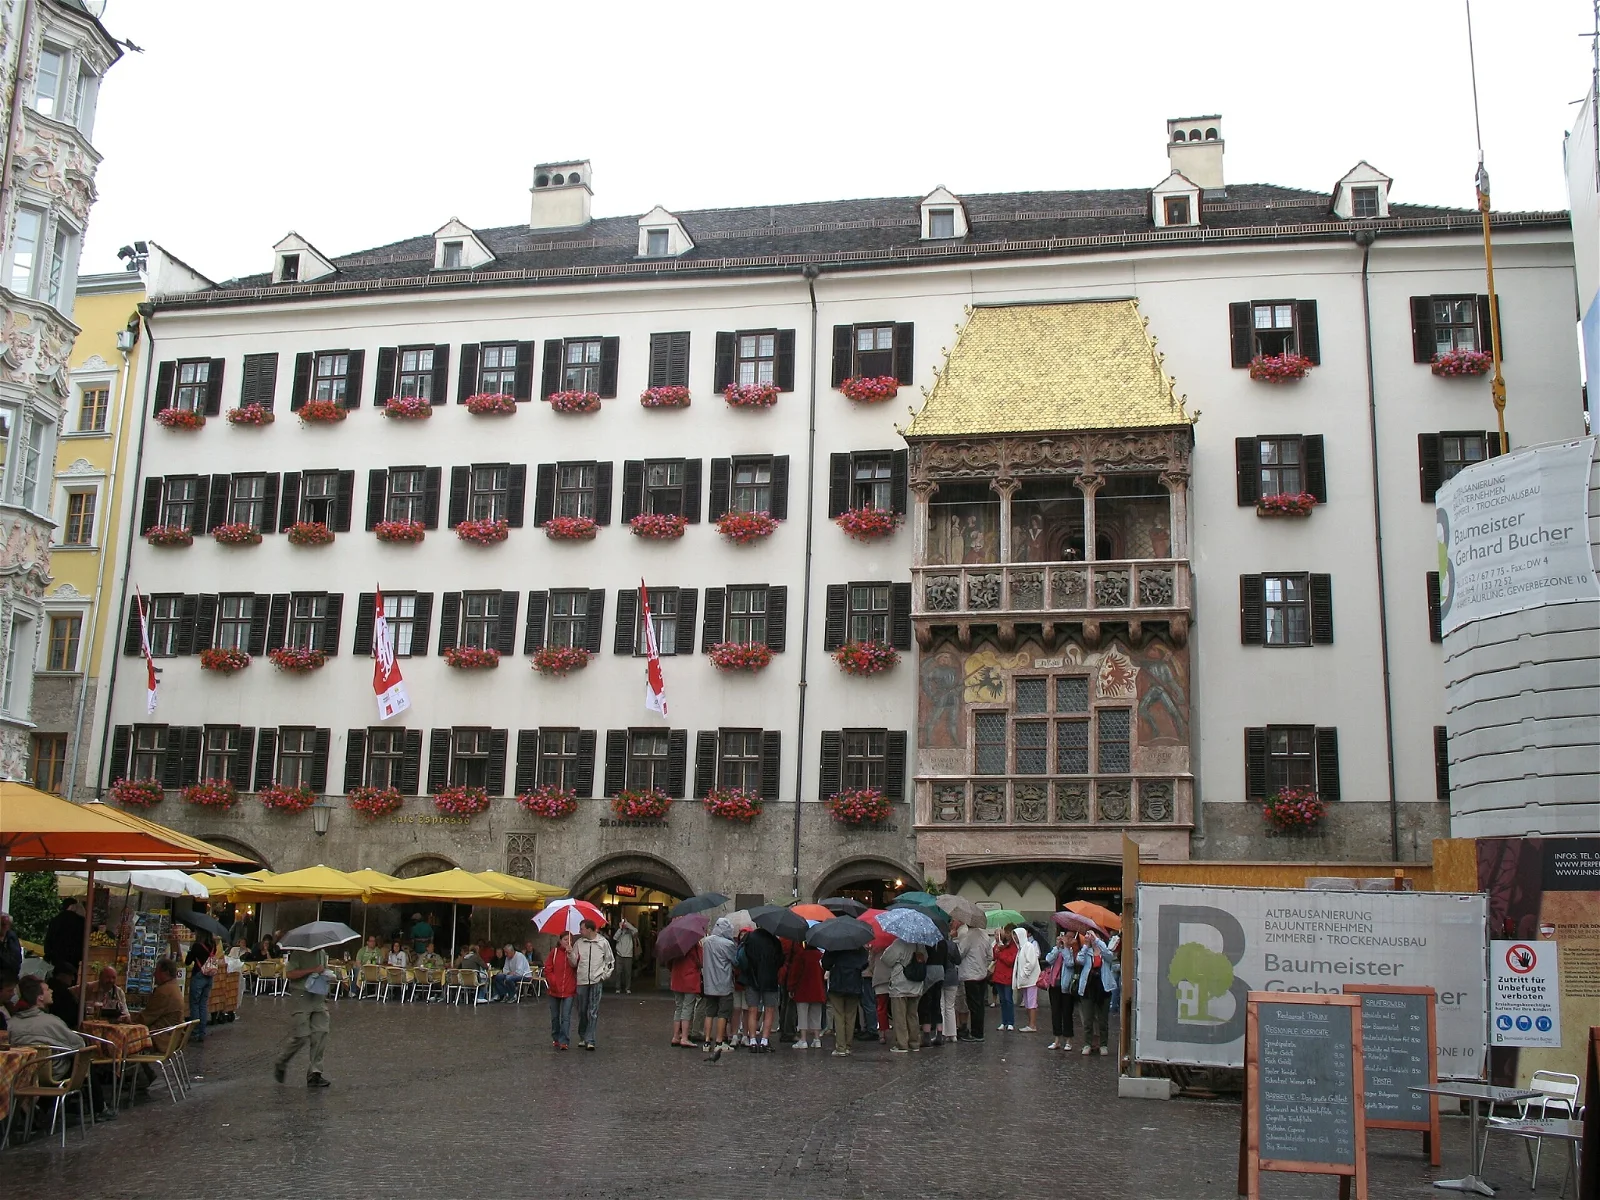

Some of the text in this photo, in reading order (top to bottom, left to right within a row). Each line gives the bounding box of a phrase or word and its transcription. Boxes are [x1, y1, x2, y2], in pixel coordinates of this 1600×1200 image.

[1476, 485, 1541, 511] TROCKENAUSBAU
[1454, 512, 1525, 545] Baumeister
[1455, 526, 1574, 566] Gerhard Bucher
[1543, 556, 1549, 564] 4
[1507, 575, 1573, 596] GEWERBEZONE
[1576, 575, 1588, 584] 10
[1265, 908, 1373, 921] ALTBAUSANIERUNG
[1264, 921, 1373, 933] BAUUNTERNEHMEN
[1265, 933, 1427, 947] ZIMMEREI TROCKENAUSBAU
[1264, 953, 1405, 976] Baumeister
[1498, 976, 1545, 984] Zutritt für
[1497, 984, 1546, 993] Unbefugte
[1501, 992, 1544, 1000] verboten
[1462, 1047, 1474, 1057] 10
